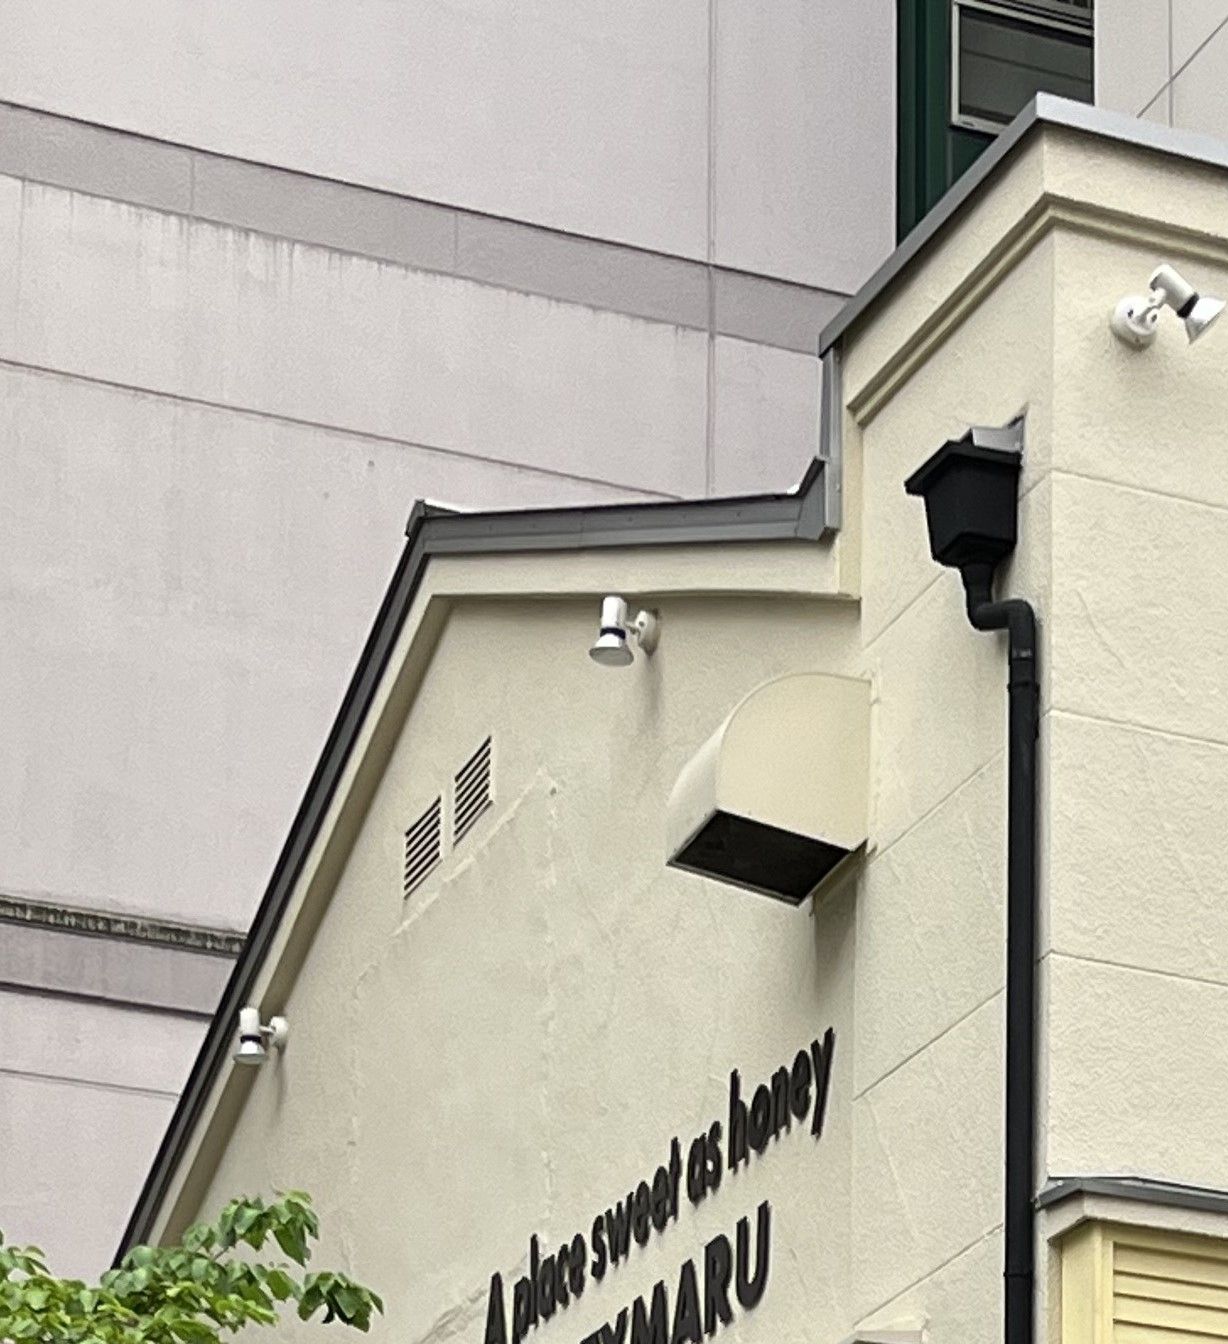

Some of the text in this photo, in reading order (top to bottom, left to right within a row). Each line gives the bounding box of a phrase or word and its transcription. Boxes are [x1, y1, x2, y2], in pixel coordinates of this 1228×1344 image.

[590, 1136, 682, 1282] sweet
[686, 1121, 723, 1205] as
[727, 1026, 836, 1174] honey
